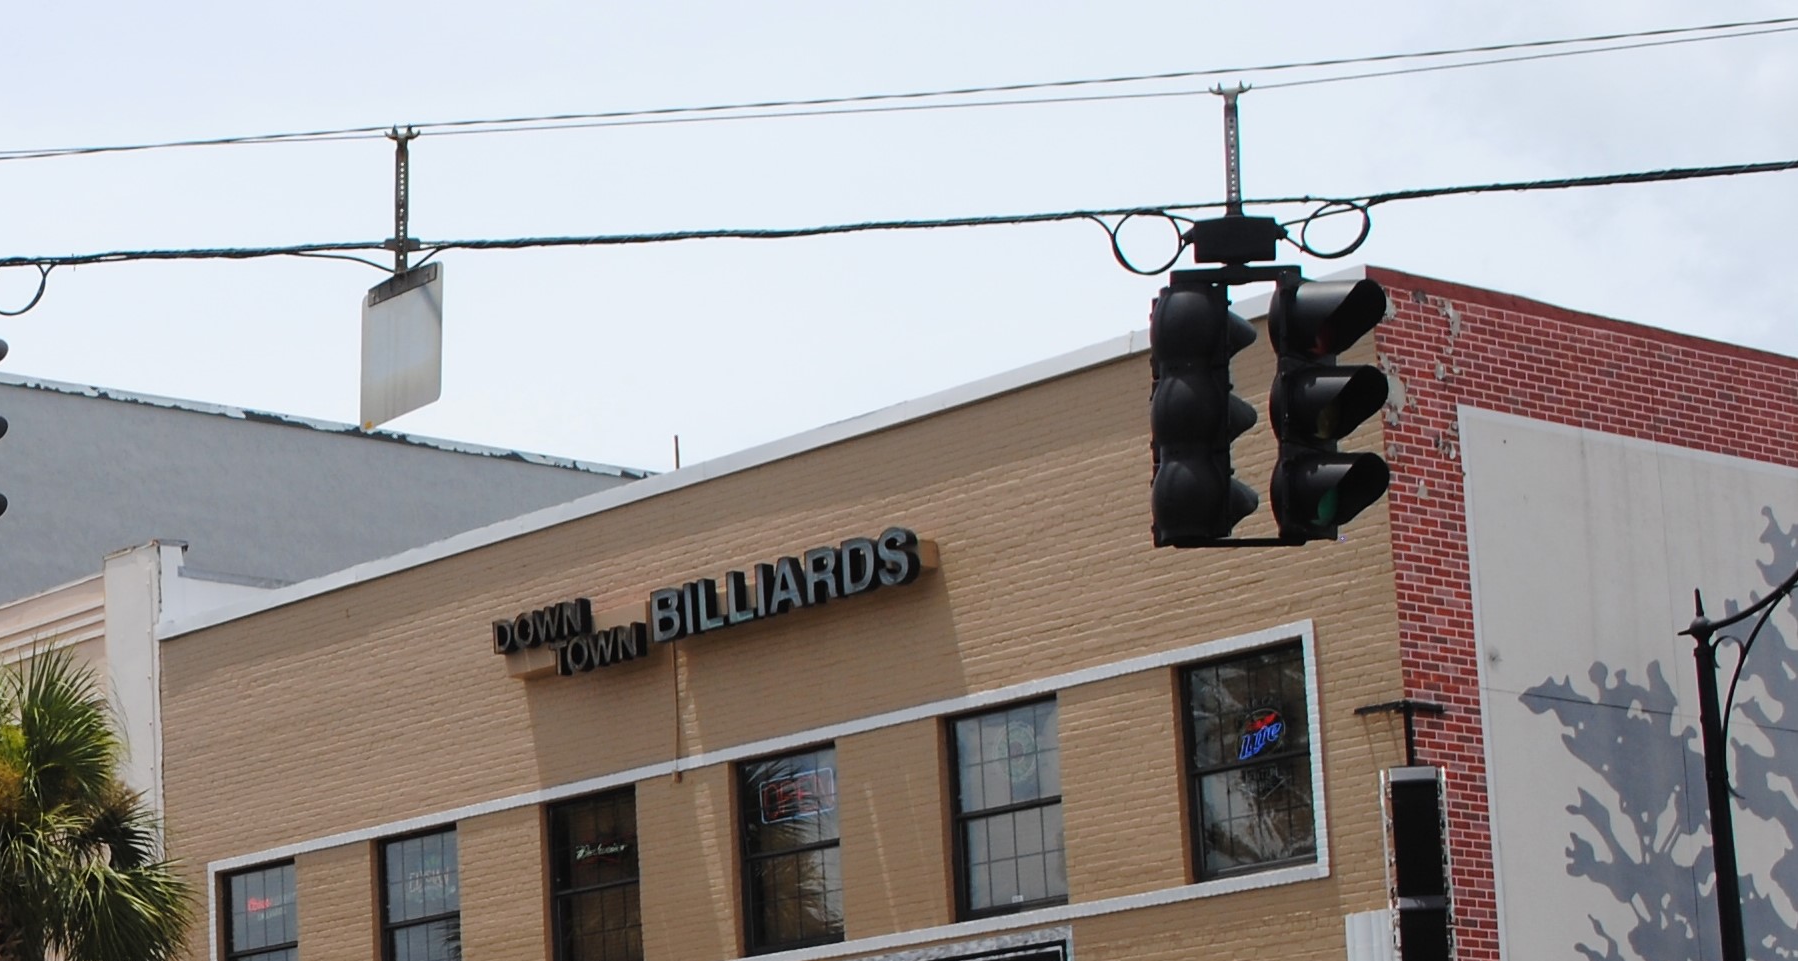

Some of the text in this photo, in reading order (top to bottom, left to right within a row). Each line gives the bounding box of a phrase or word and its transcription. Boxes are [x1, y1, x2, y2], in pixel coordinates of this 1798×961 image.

[650, 526, 920, 642] BILLIARDS
[492, 598, 592, 654] DOWN
[550, 621, 647, 675] TOWN
